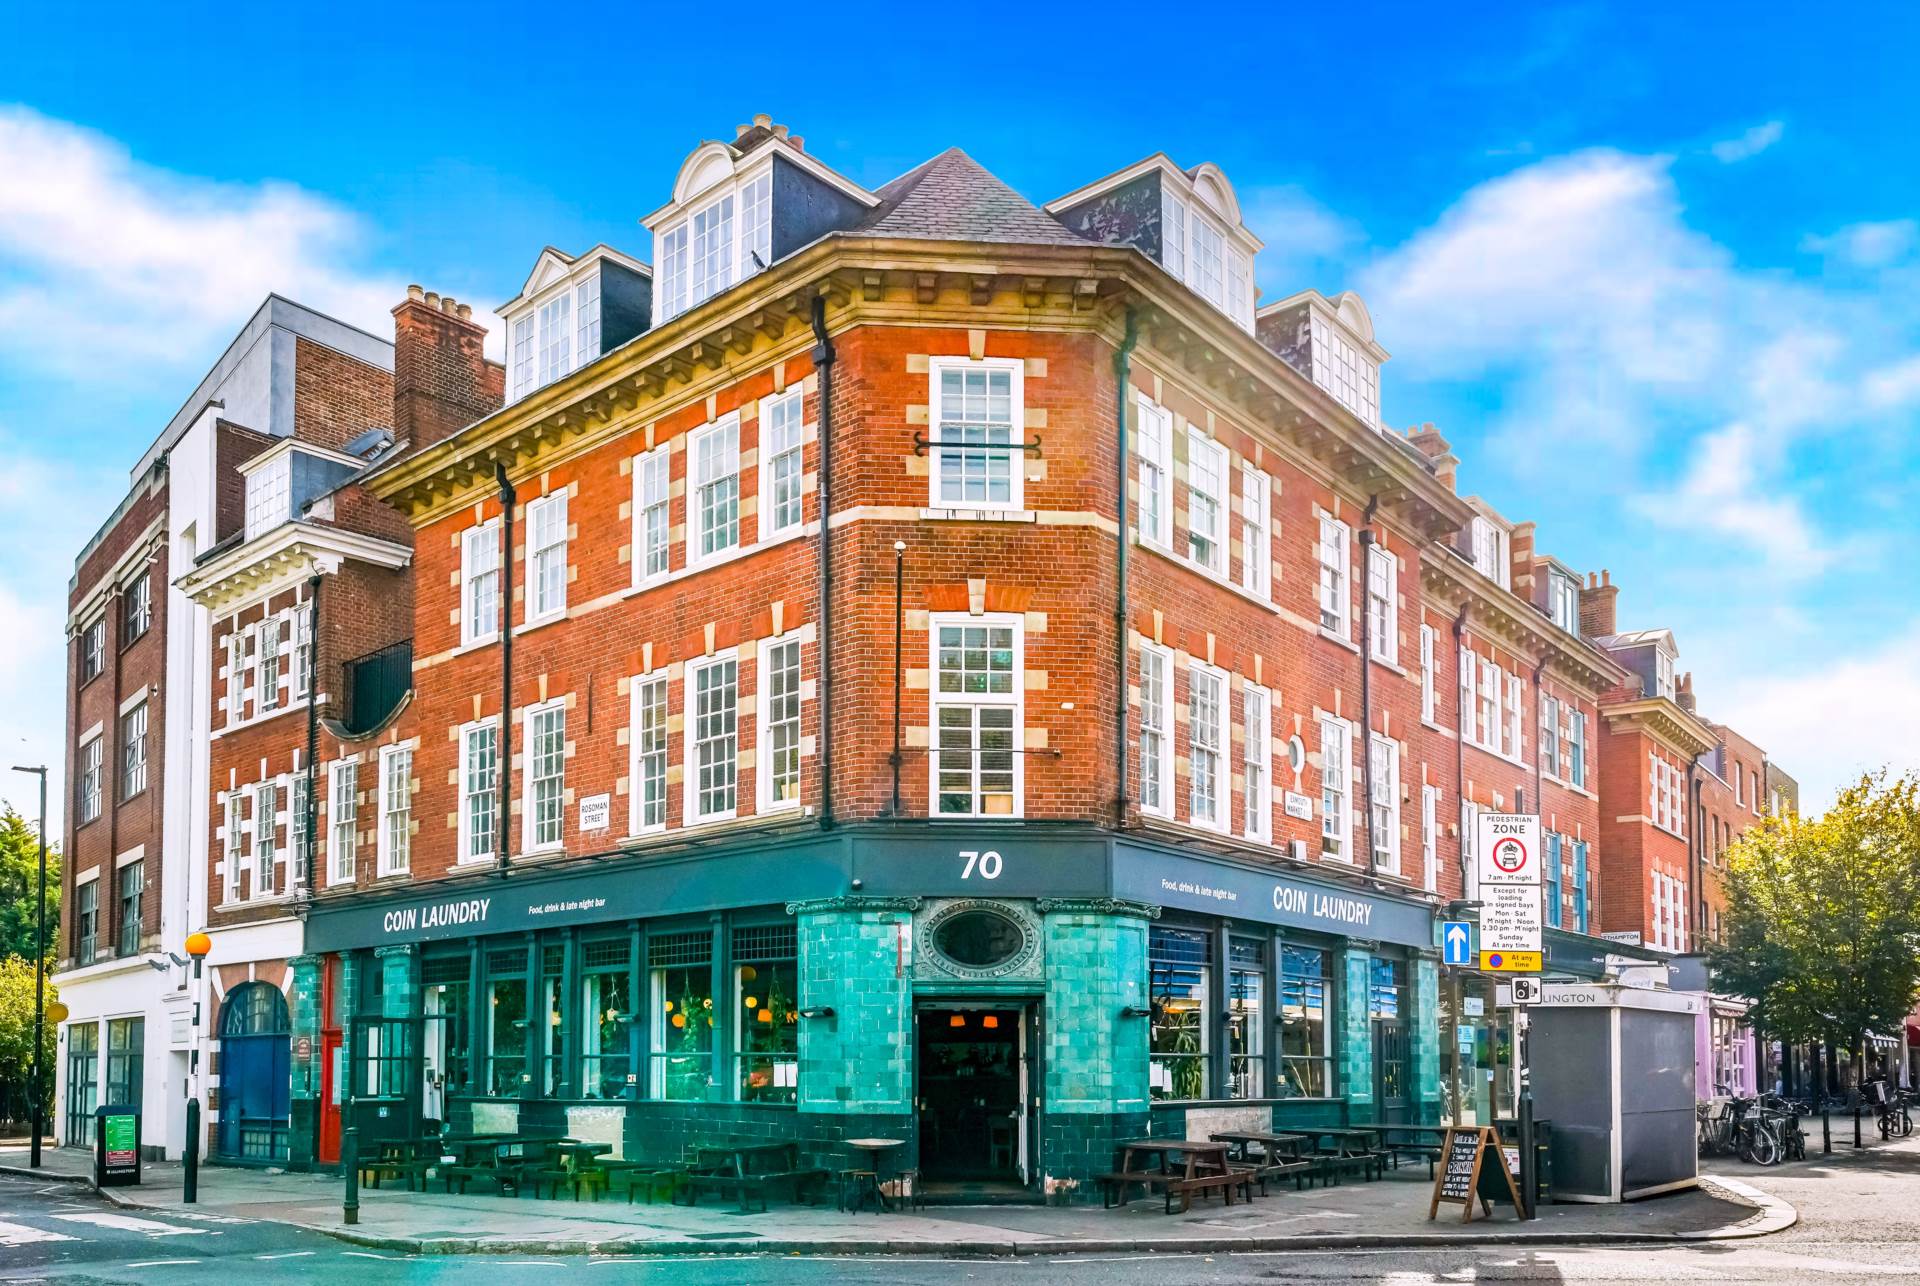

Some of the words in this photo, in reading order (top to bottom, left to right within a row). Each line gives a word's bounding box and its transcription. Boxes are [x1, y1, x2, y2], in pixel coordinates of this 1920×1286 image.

[582, 801, 608, 812] ROSOMAN
[584, 812, 604, 824] STREET
[1493, 824, 1526, 834] ZONE
[958, 851, 1003, 880] 70
[1162, 878, 1178, 892] Food,
[1179, 881, 1194, 894] drink
[1195, 884, 1200, 894] &
[1201, 886, 1212, 896] late
[1213, 888, 1227, 901] night
[1228, 891, 1237, 900] bar
[384, 908, 416, 932] COIN
[421, 898, 490, 928] LAUNDRY
[528, 904, 543, 915] Food,
[544, 902, 560, 912] drink
[560, 902, 565, 911] &
[566, 900, 578, 910] late
[578, 898, 594, 910] night
[595, 898, 606, 907] bar
[1273, 886, 1307, 914] COIN
[1313, 894, 1372, 926] LAUNDRY
